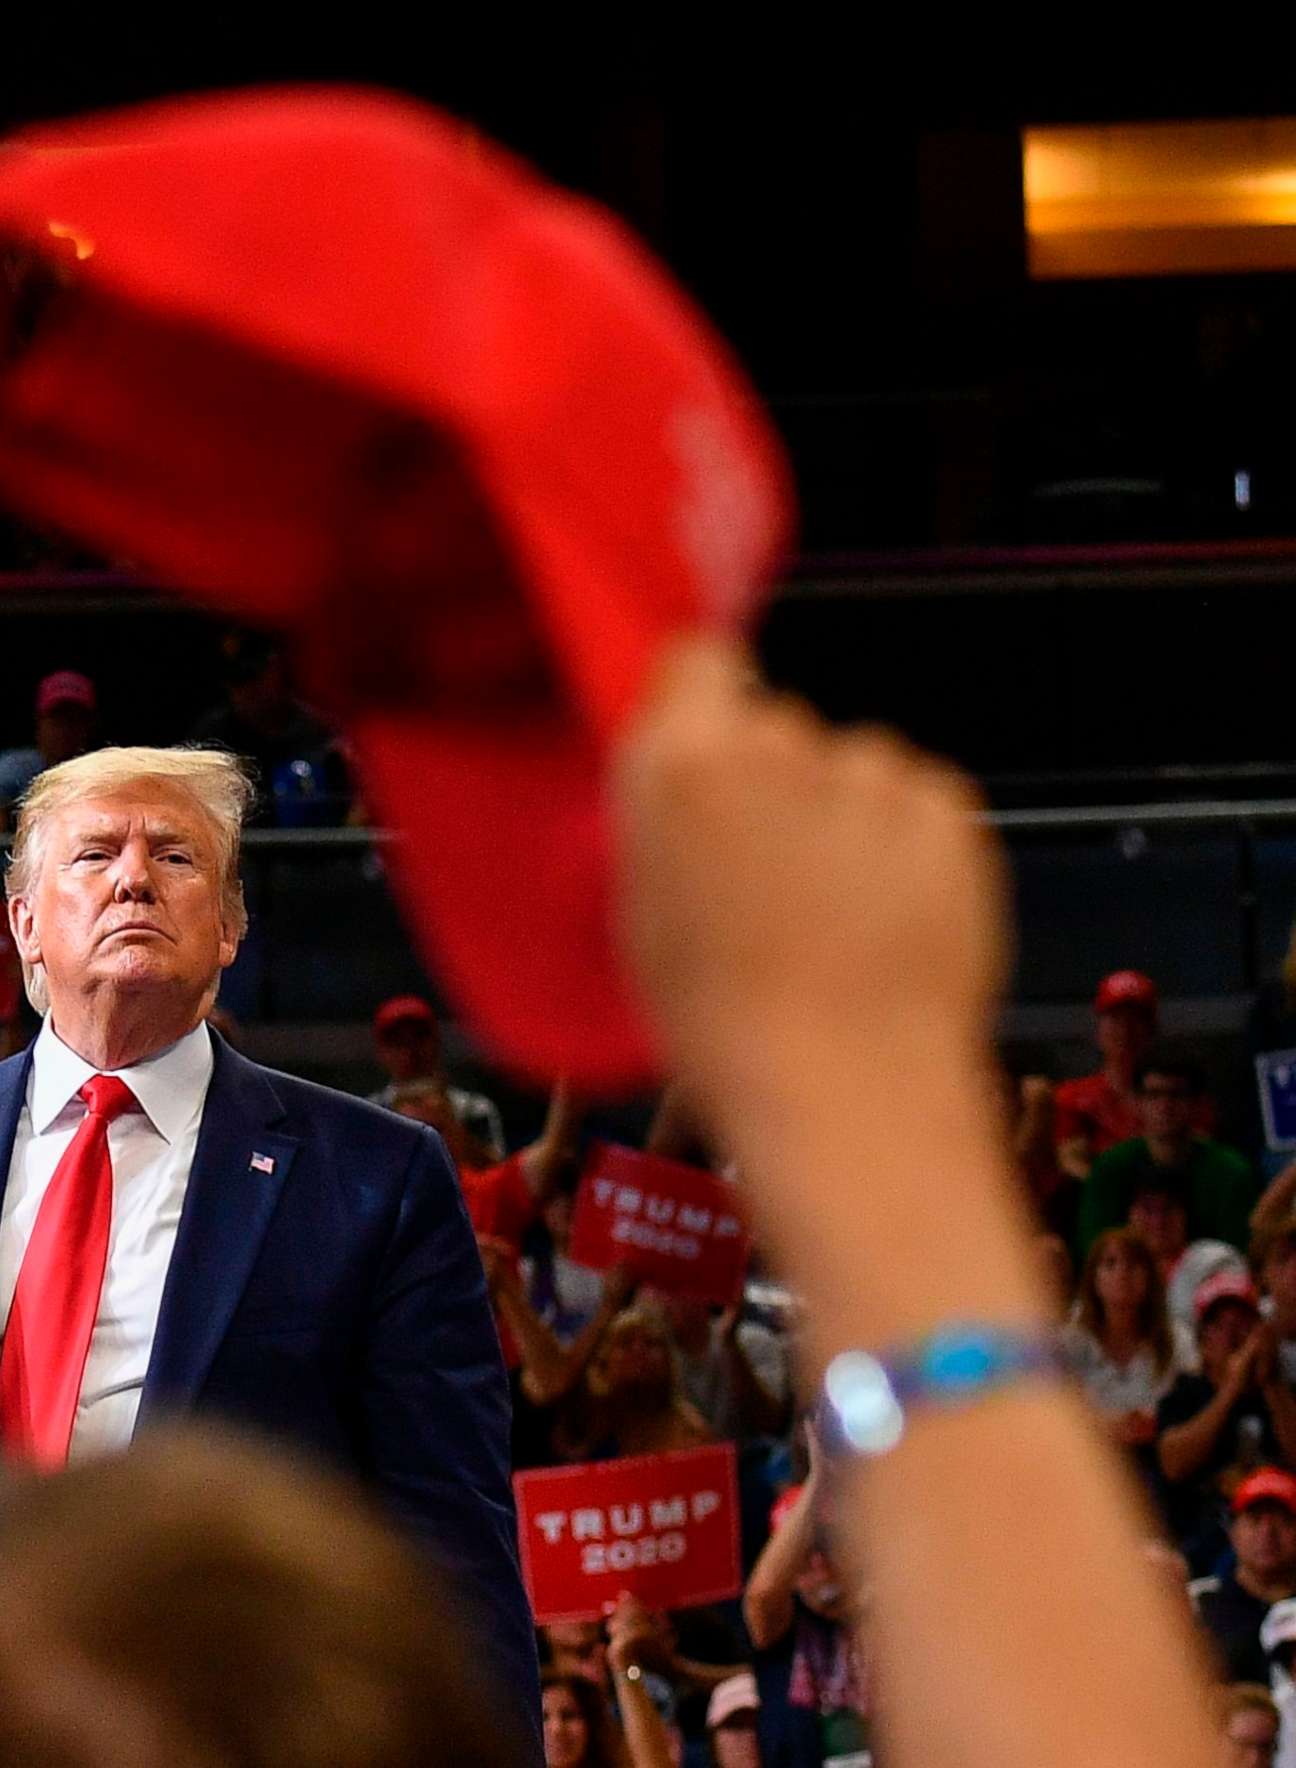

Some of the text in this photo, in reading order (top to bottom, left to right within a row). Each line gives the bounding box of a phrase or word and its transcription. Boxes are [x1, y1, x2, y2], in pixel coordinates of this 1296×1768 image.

[592, 1177, 742, 1239] TRUMP
[611, 1216, 700, 1260] 2020
[534, 1489, 722, 1545] TRUMP
[581, 1530, 687, 1576] 2020
